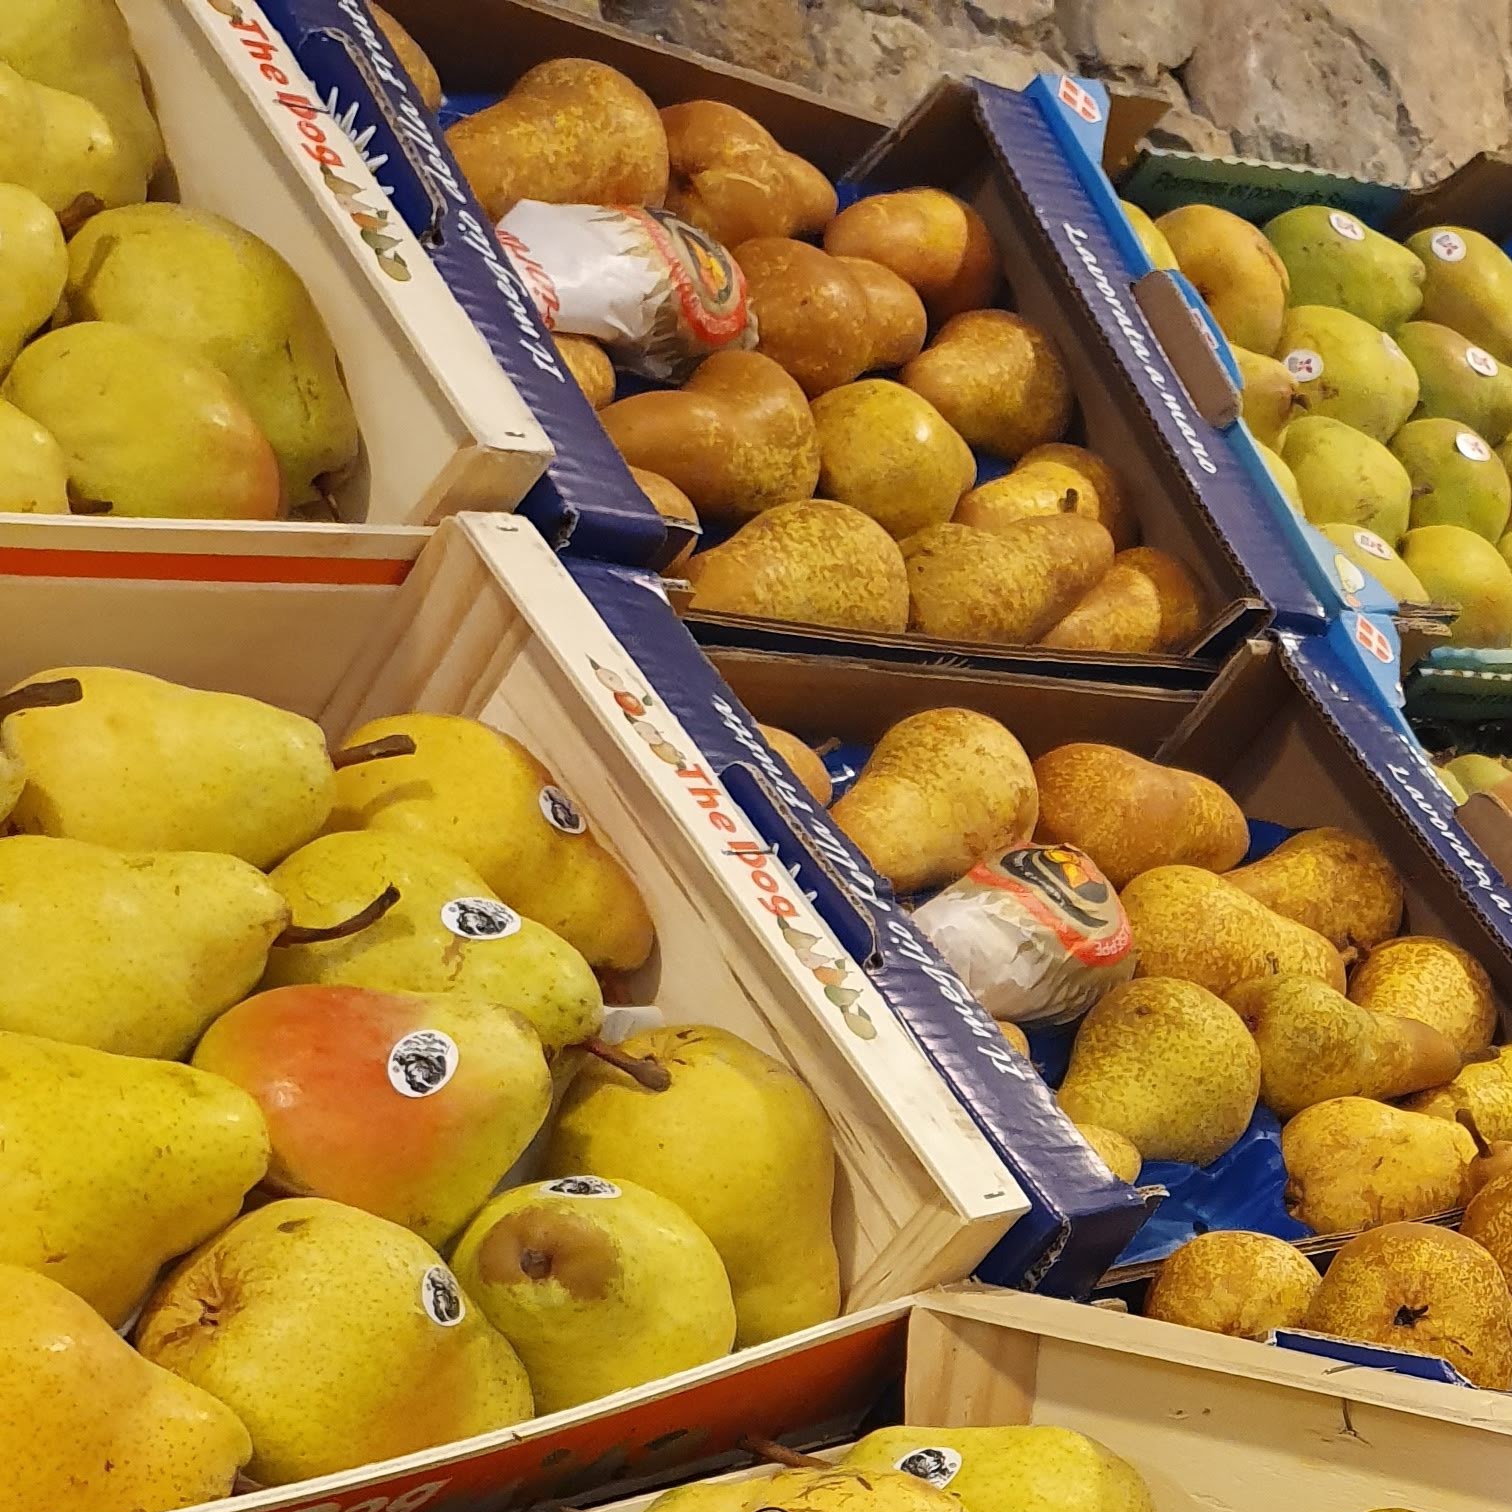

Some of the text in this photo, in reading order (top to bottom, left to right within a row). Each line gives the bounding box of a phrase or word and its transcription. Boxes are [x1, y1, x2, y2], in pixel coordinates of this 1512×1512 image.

[229, 19, 345, 168] The Dog
[396, 95, 467, 204] della
[457, 210, 541, 339] meglio
[1062, 221, 1217, 474] Lavorata a mano
[710, 691, 815, 815] Frutta
[674, 763, 801, 919] The Dog
[811, 817, 892, 913] della
[1387, 762, 1494, 892] Lavorata
[1489, 892, 1512, 916] a
[887, 919, 993, 1040] meglio
